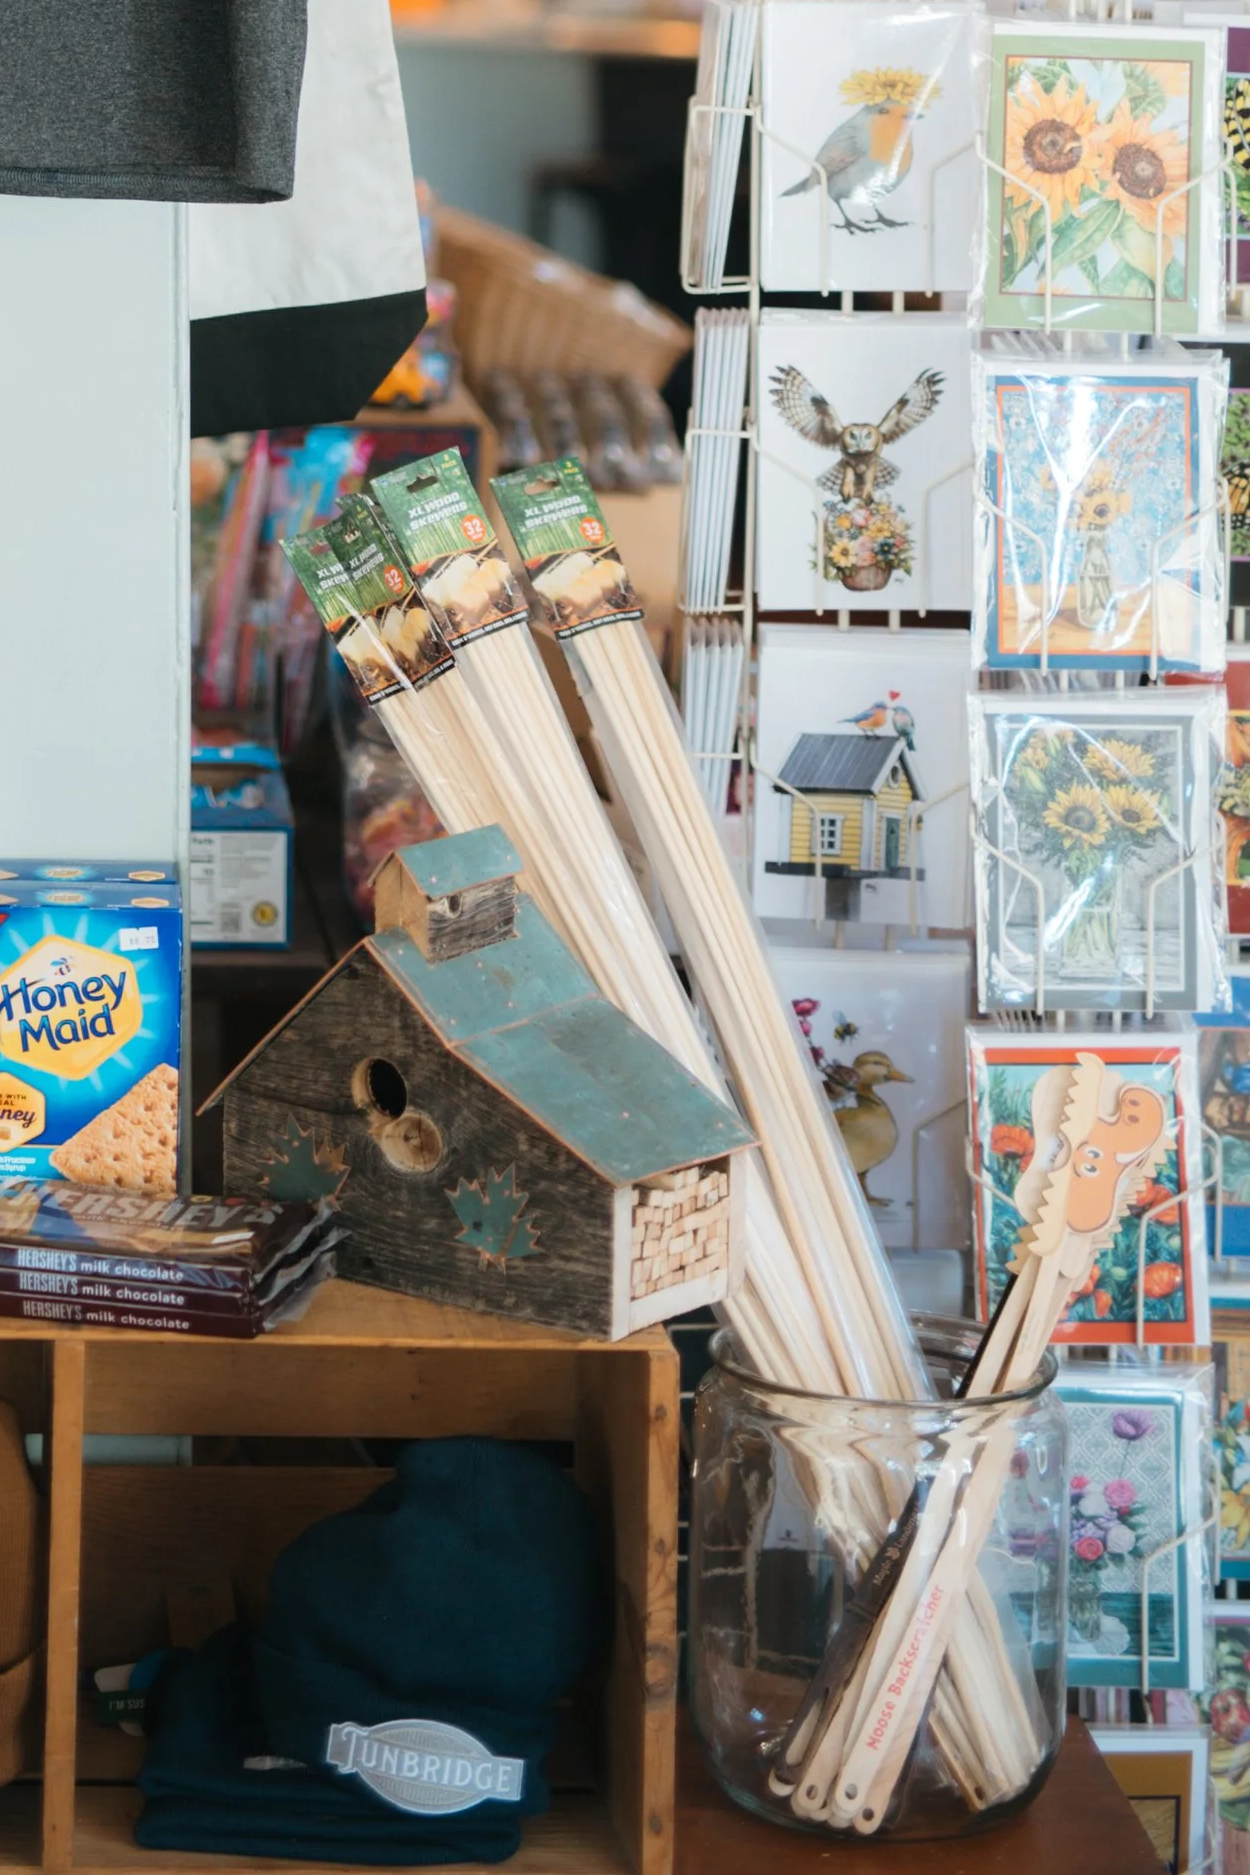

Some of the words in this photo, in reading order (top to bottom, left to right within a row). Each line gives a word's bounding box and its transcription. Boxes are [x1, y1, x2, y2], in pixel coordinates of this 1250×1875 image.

[463, 518, 484, 536] 32
[384, 568, 402, 587] 32
[18, 1003, 116, 1052] Maid
[17, 1248, 77, 1272] HERSHEY'S
[80, 1260, 111, 1274] milk
[114, 1263, 185, 1282] chocolate
[19, 1272, 78, 1295] HERSHEY'S
[82, 1282, 112, 1298] milk
[116, 1287, 185, 1306] chocolate
[22, 1299, 83, 1321] HERSHEY'S
[86, 1309, 116, 1323] milk
[120, 1312, 190, 1330] chocolate
[866, 1701, 896, 1751] Moose
[339, 1726, 513, 1793] TUNBRIDGE
